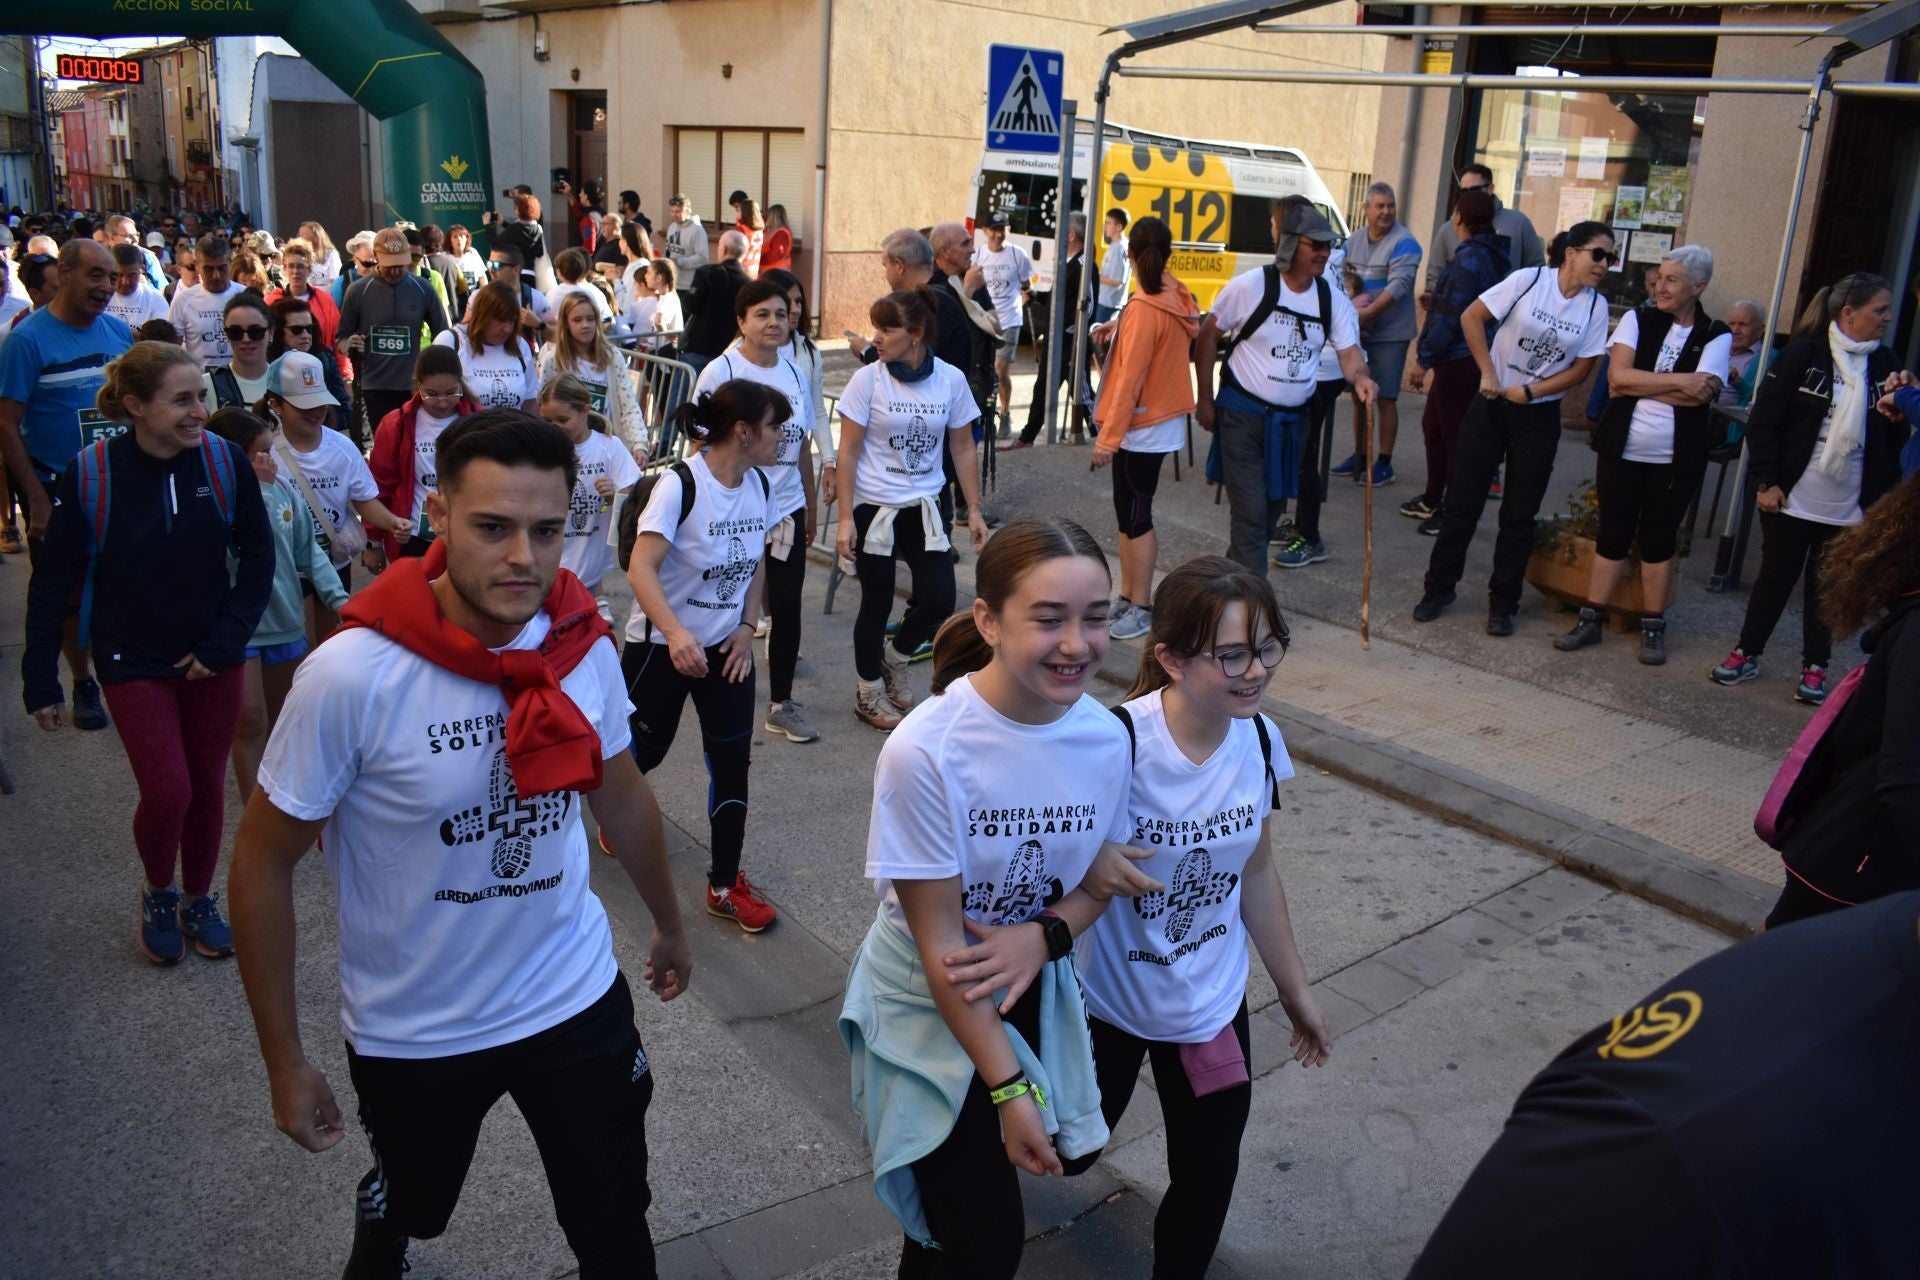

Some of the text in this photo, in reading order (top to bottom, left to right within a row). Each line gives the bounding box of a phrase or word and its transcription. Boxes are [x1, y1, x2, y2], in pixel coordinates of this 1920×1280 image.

[190, 0, 254, 11] SOCIAL
[422, 182, 484, 194] CAJA RURAL
[421, 192, 487, 203] DE NAVARRA
[1000, 191, 1017, 208] 112
[1151, 186, 1226, 253] 112
[378, 338, 404, 350] 569
[888, 406, 947, 415] SOLIDARIA
[708, 524, 765, 537] SOLIDARIA
[968, 804, 1096, 823] CARRERA-MARCHA
[1136, 804, 1255, 833] CARRERA-MARCHA
[968, 818, 1094, 837] SOLIDARIA
[1135, 817, 1254, 847] SOLIDARIA
